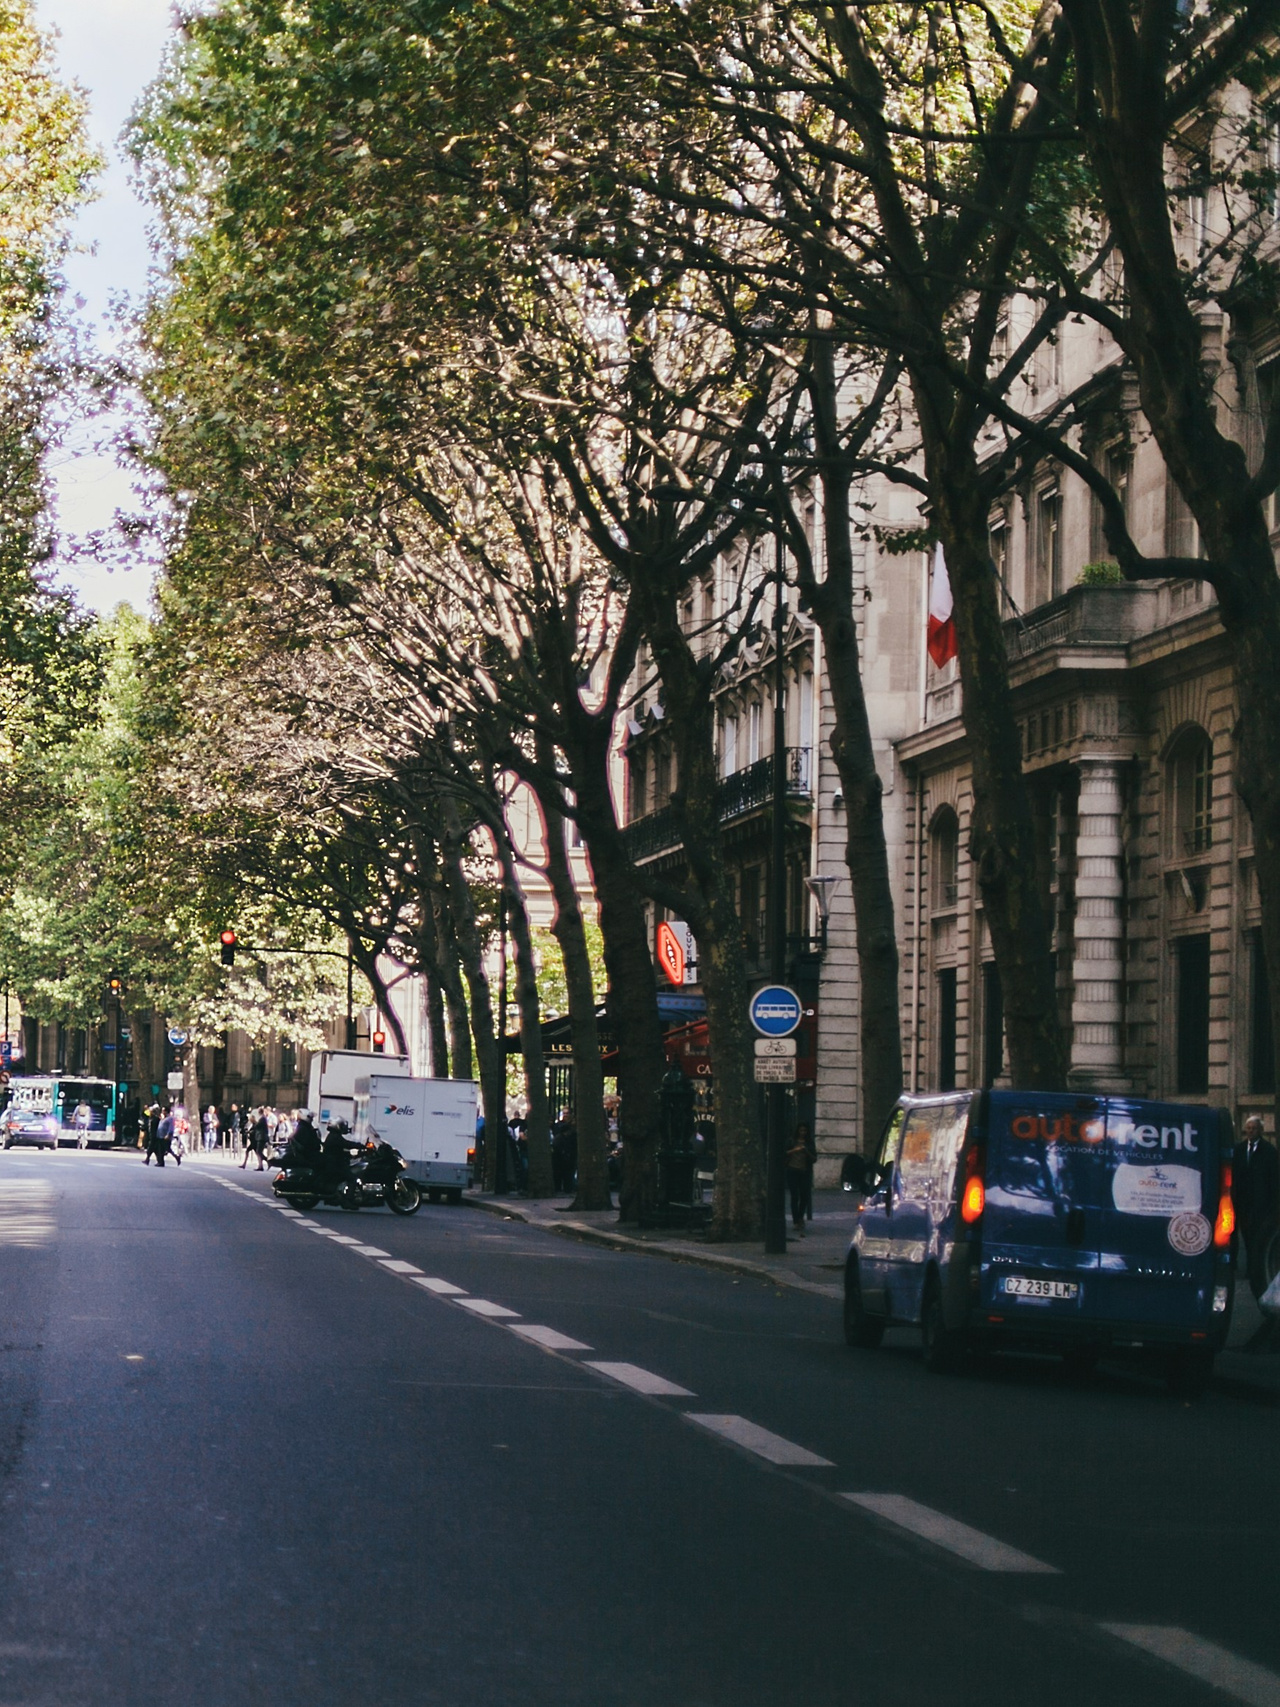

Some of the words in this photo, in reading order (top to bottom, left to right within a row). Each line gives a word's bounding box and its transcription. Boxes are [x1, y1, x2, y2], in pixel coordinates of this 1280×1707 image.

[666, 938, 677, 969] TABAC
[551, 1044, 573, 1052] LES
[396, 1105, 415, 1116] elis
[1046, 1145, 1095, 1155] LOCATION
